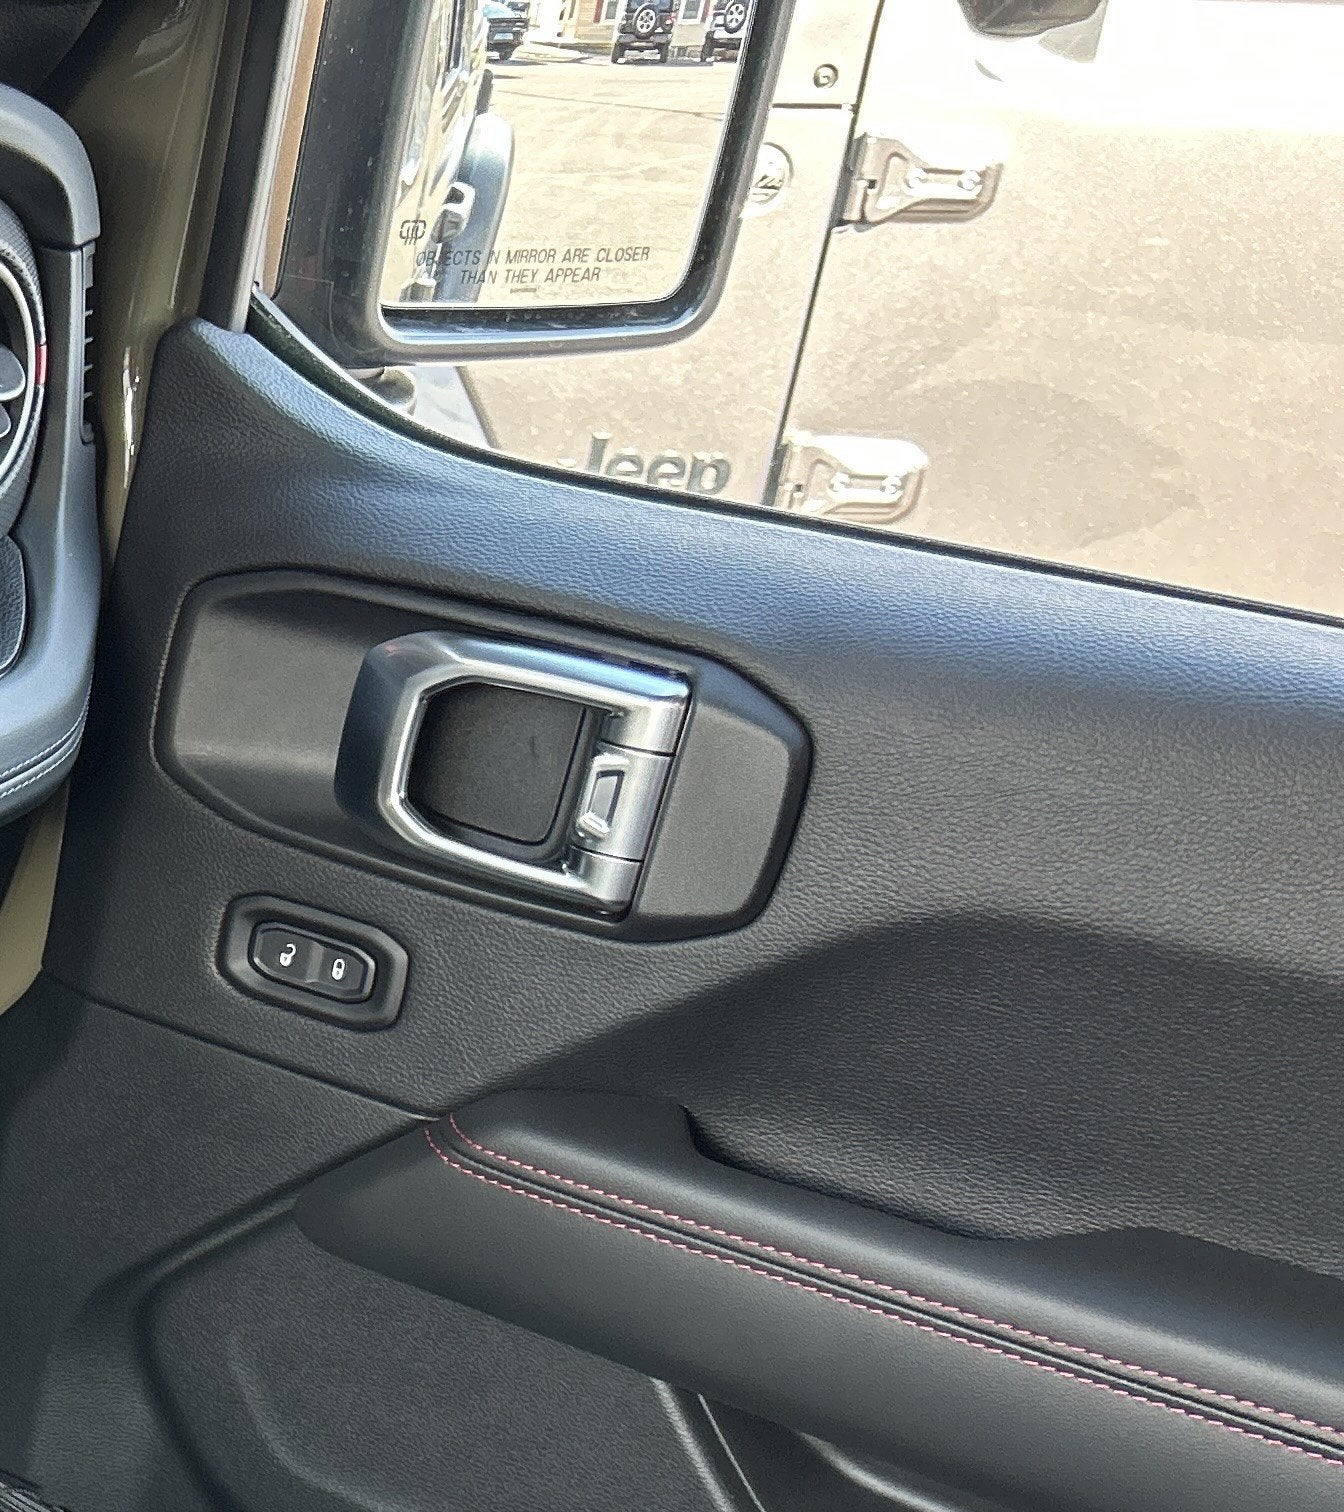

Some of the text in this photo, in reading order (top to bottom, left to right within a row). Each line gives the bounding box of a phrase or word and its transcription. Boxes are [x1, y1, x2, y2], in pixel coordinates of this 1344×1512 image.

[506, 249, 556, 265] MIRROR
[562, 248, 588, 263] ARE
[596, 246, 650, 262] CLOSER
[462, 266, 601, 284] THAN THEY APPEAR
